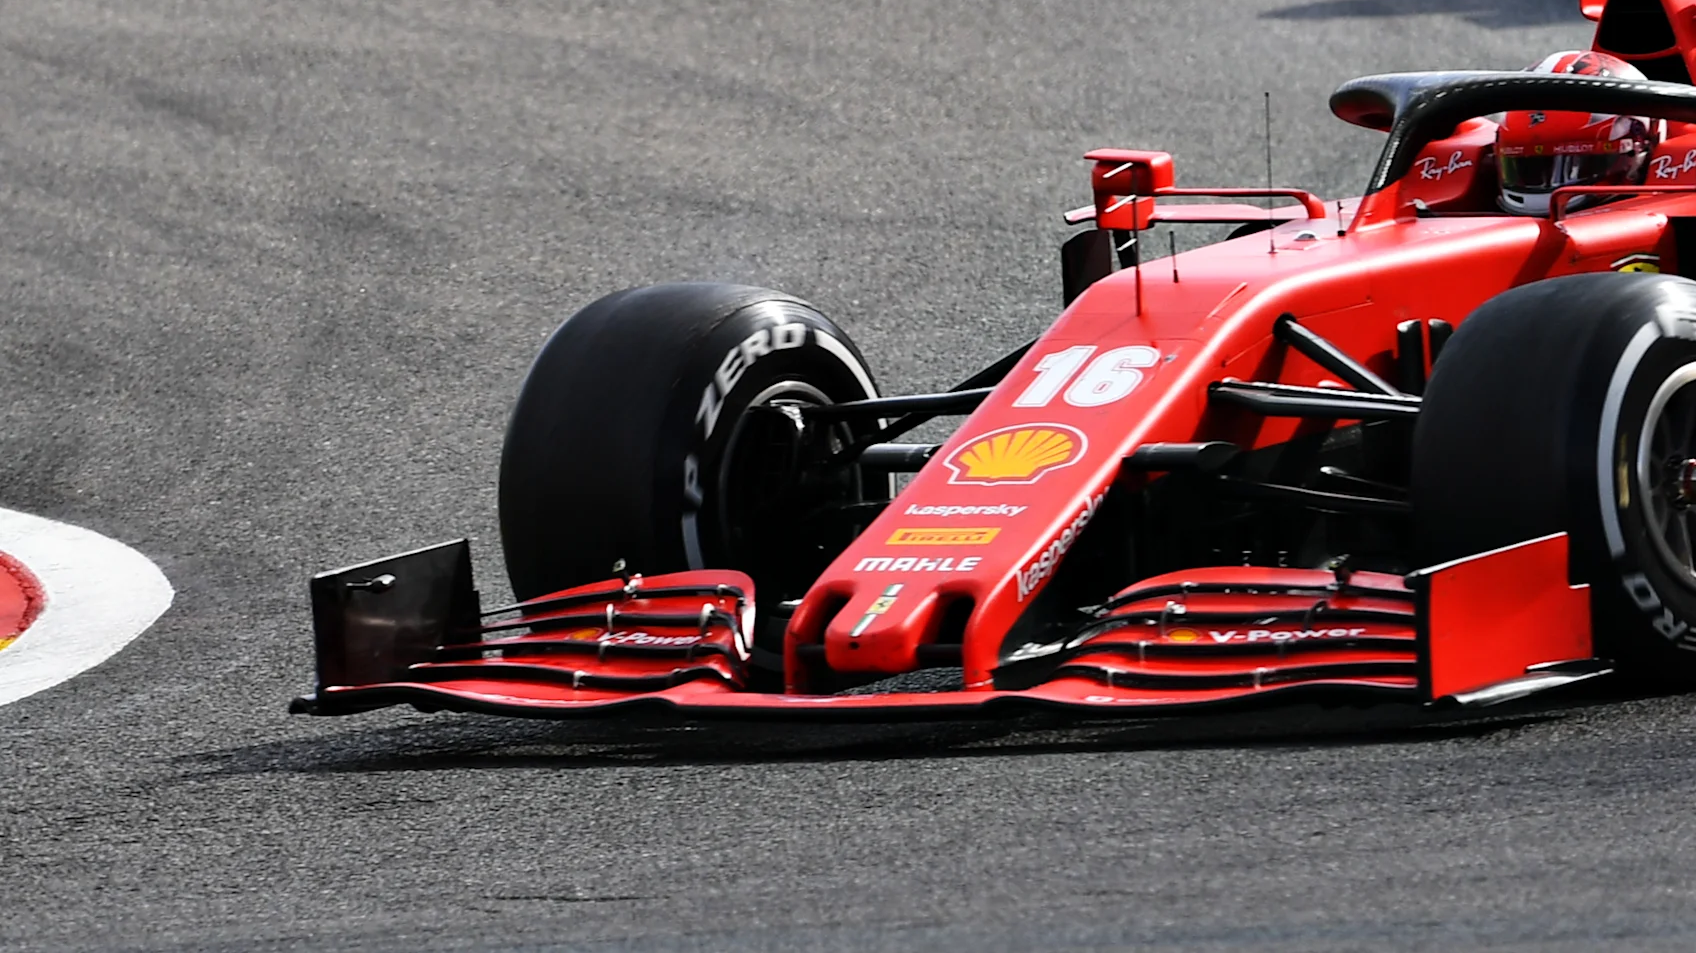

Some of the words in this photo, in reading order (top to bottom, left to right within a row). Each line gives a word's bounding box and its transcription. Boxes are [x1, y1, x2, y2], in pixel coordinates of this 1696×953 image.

[1414, 150, 1472, 180] Ray-Ban
[695, 323, 807, 442] ZERO
[1012, 345, 1161, 408] 16
[903, 504, 1029, 517] kaspersky
[854, 556, 983, 572] MAHLE
[597, 631, 702, 646] V-Power
[1208, 628, 1366, 643] V-Power
